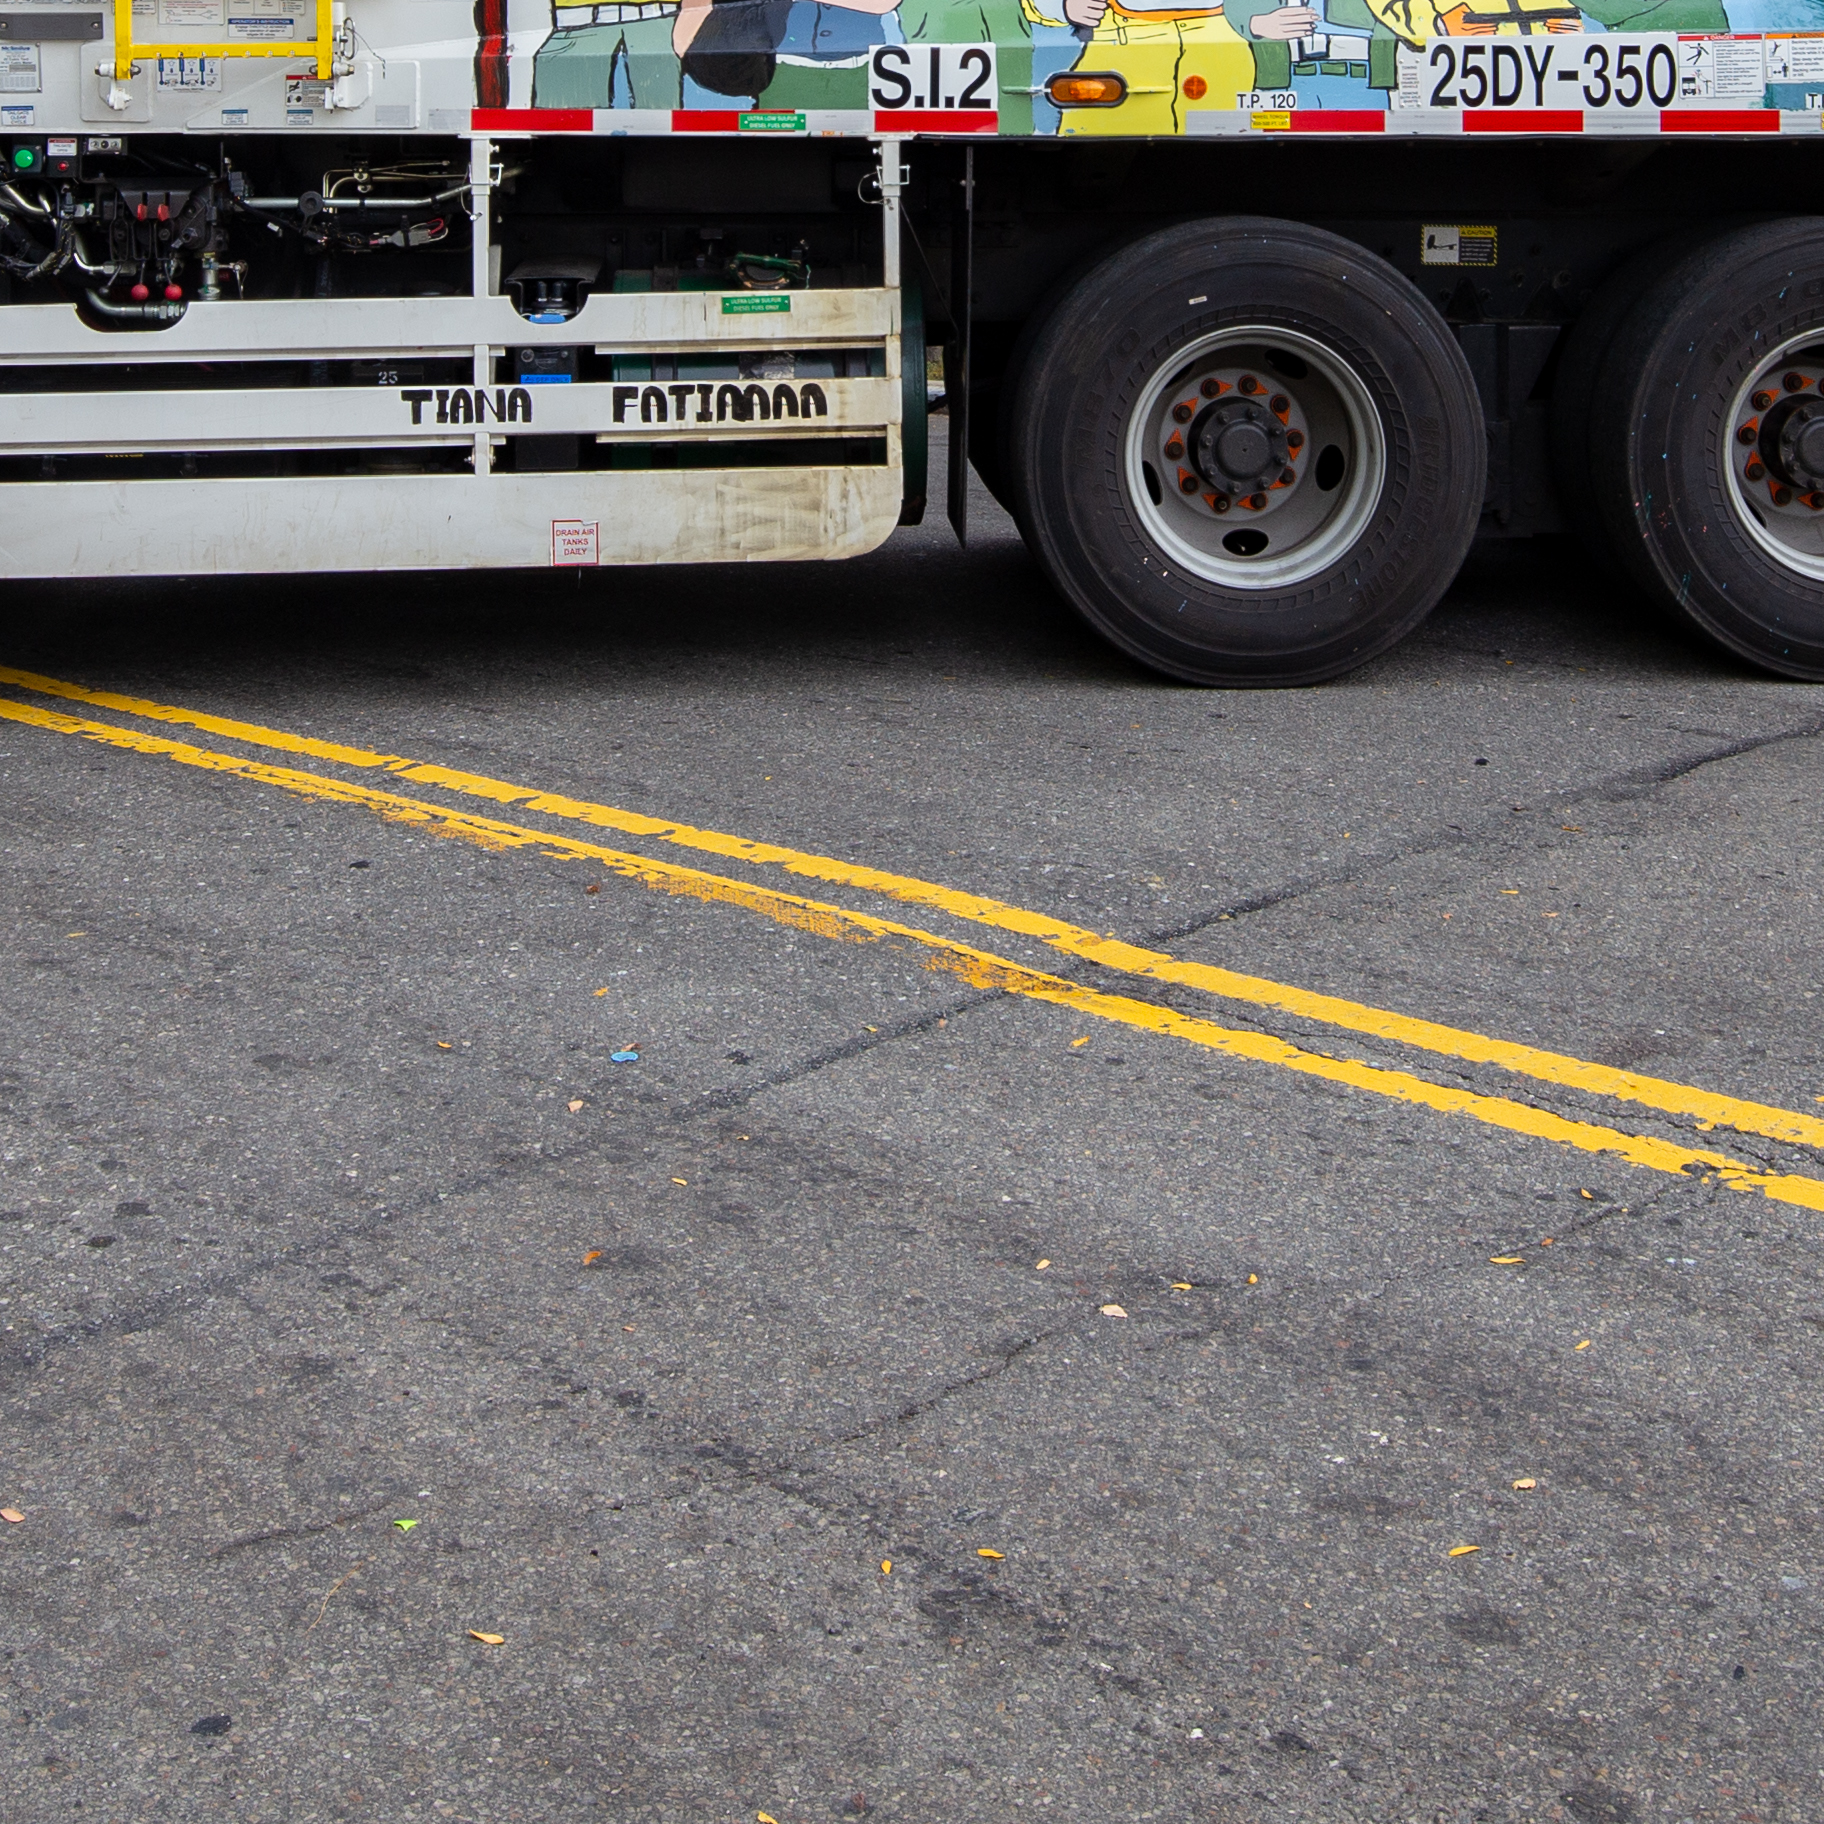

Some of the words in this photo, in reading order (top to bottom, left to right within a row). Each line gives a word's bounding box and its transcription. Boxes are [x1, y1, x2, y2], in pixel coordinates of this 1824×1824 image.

[871, 45, 992, 109] S.I.2
[1429, 43, 1677, 107] 25DY-350
[1237, 93, 1264, 109] T.P.
[1270, 93, 1297, 109] 120
[378, 370, 398, 385] 25
[401, 387, 532, 426] TIANA
[582, 528, 595, 536] AIR
[561, 538, 589, 546] TANKS
[563, 548, 588, 556] DAILY
